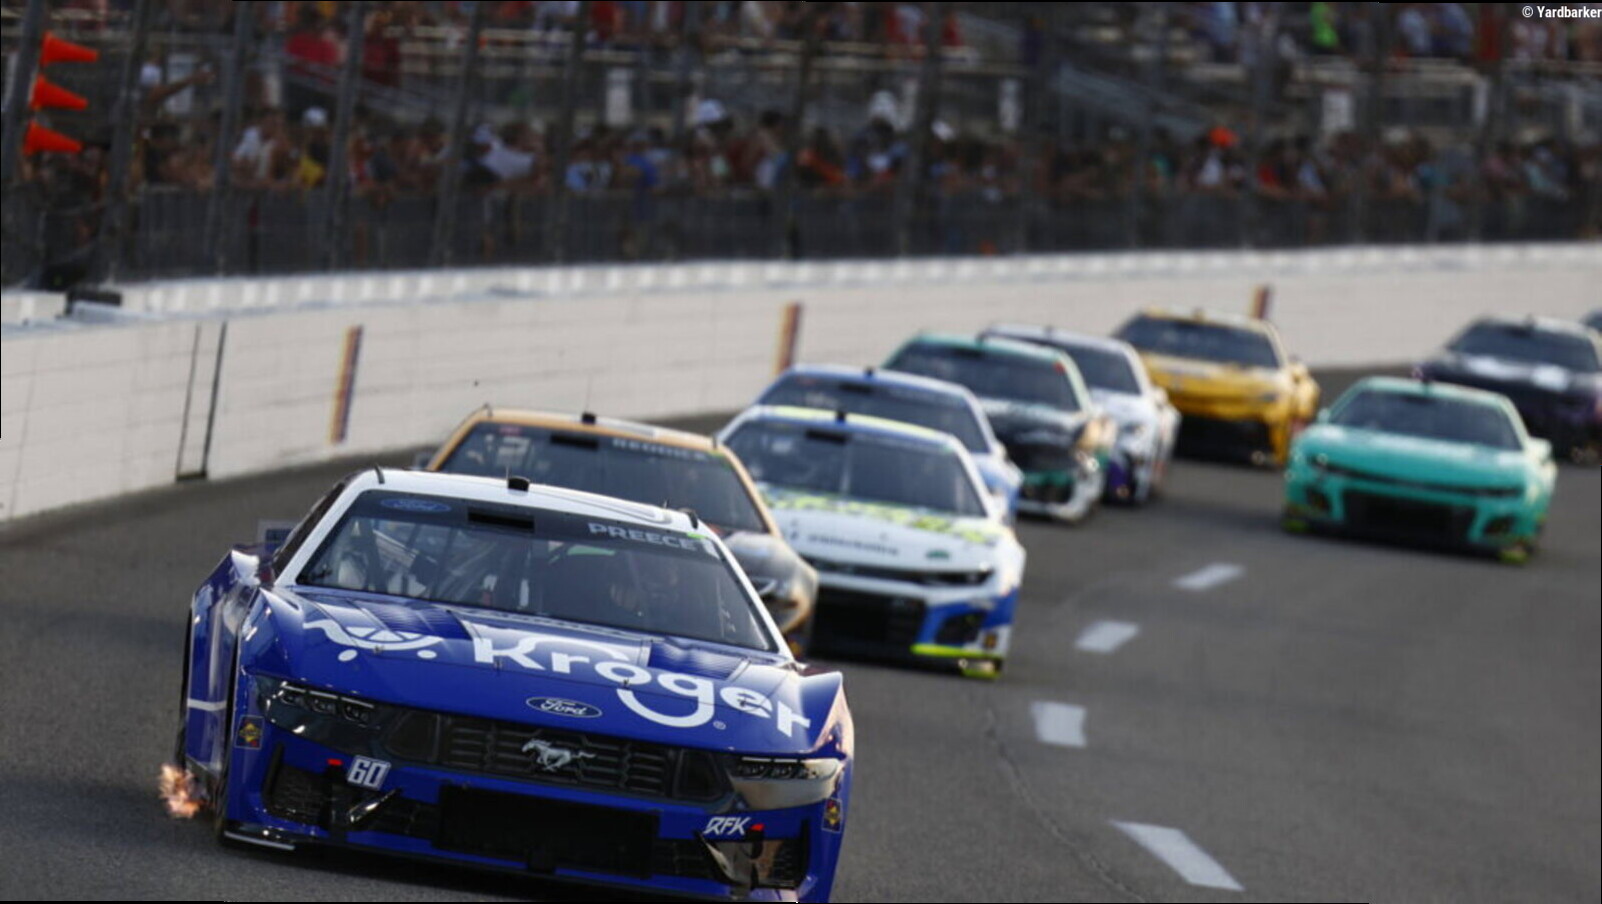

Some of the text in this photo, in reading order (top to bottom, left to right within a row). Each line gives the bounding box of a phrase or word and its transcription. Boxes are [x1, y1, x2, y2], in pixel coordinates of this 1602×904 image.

[587, 522, 698, 552] PREECE
[472, 636, 811, 738] Kroger
[347, 757, 390, 789] 60
[703, 816, 751, 836] RFK
